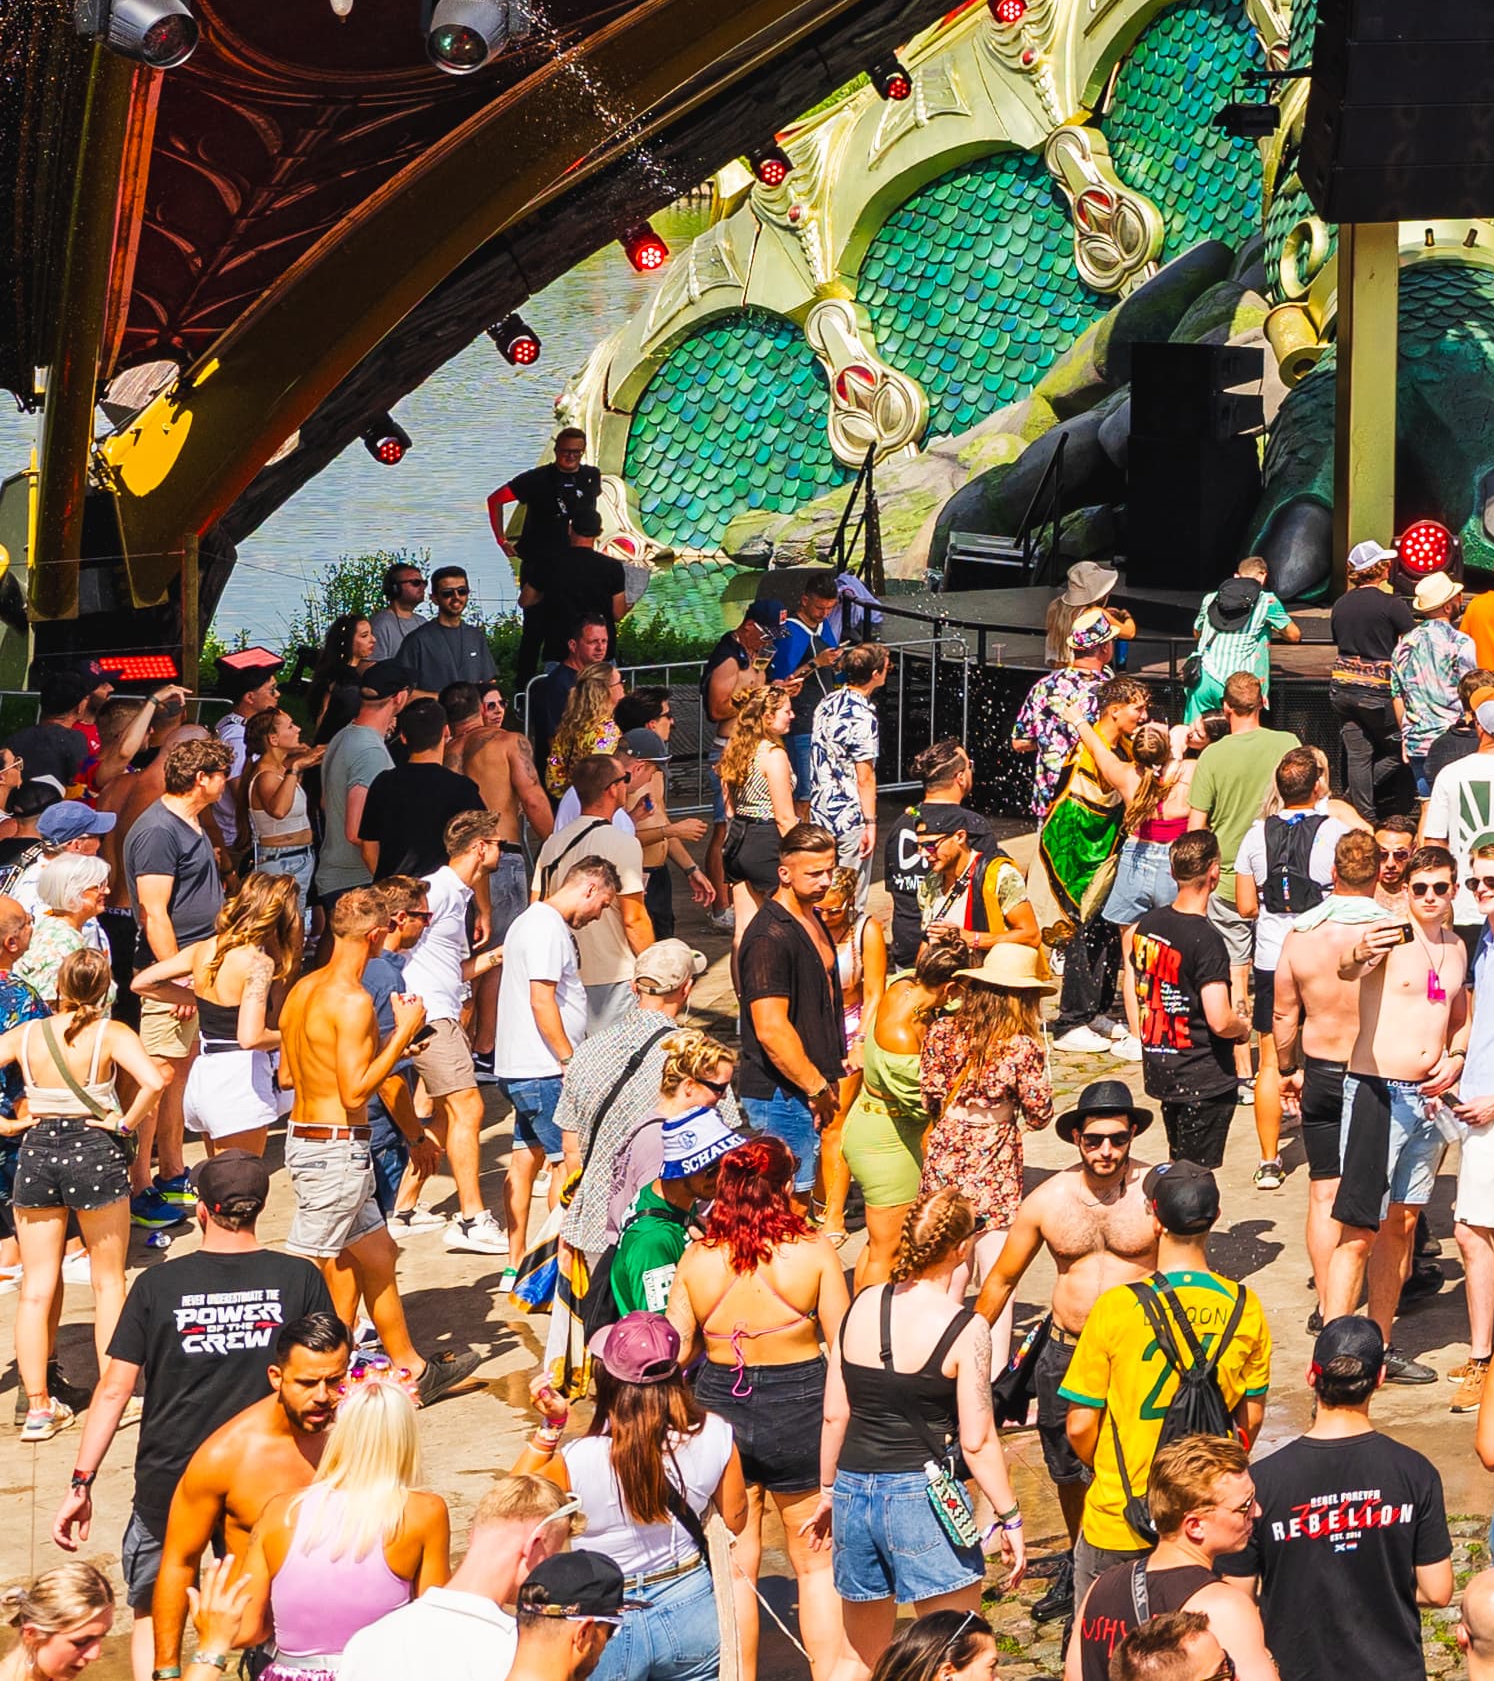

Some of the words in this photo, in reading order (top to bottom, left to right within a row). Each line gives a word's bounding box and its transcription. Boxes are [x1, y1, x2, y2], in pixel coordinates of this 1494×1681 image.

[681, 1132, 749, 1175] SCHALK
[181, 1293, 206, 1308] NEVER
[206, 1290, 265, 1306] UNDERESTIMATE
[265, 1288, 281, 1300] THE
[173, 1302, 285, 1332] POWER
[206, 1323, 225, 1334] OF
[226, 1321, 254, 1331] THE
[181, 1327, 273, 1355] CREW
[1310, 1495, 1337, 1509] REBEL
[1340, 1490, 1382, 1504] FOREVER
[1272, 1504, 1414, 1541] REBELION
